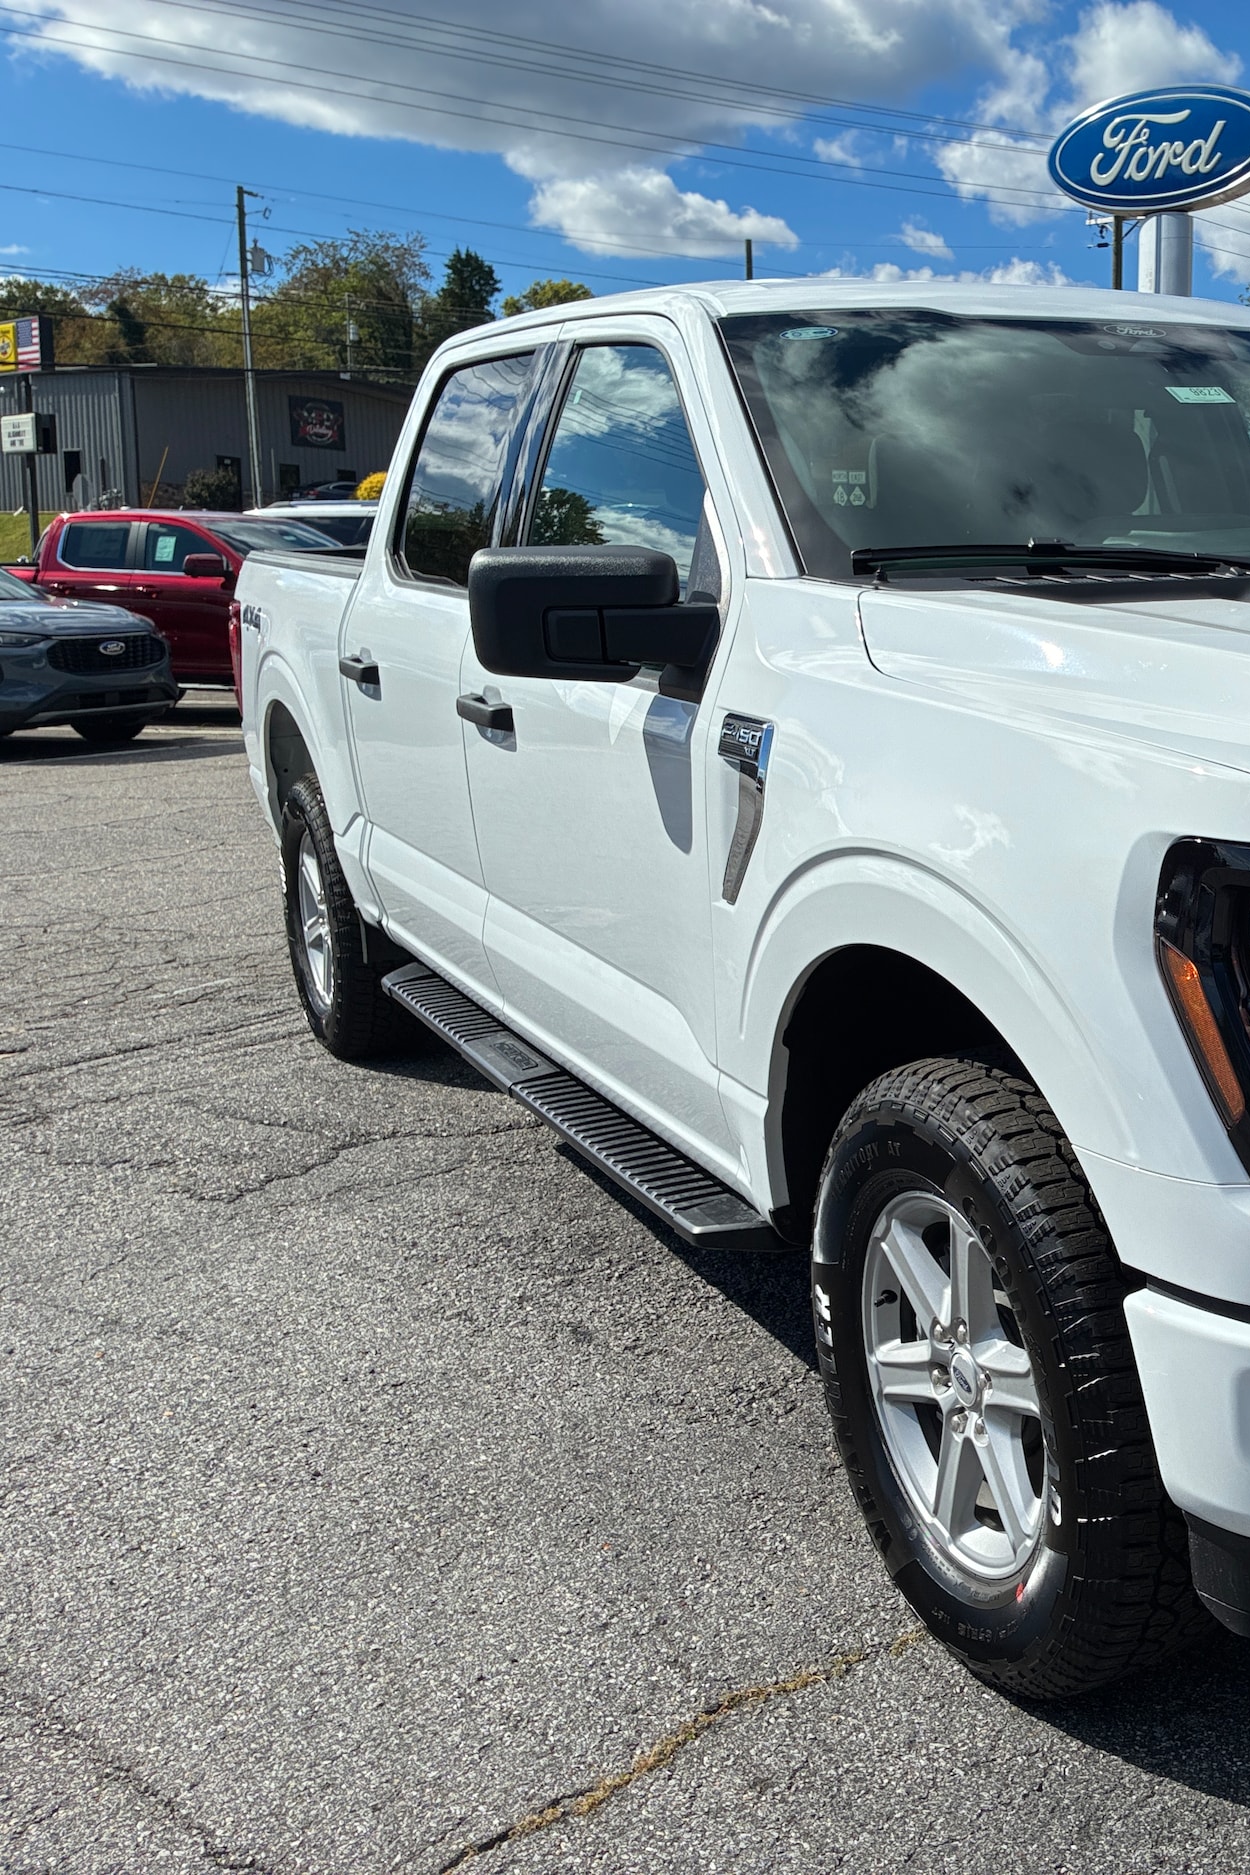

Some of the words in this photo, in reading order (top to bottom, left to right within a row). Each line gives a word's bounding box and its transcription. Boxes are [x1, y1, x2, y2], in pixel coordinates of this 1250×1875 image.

[1090, 109, 1227, 187] Ford
[1116, 326, 1157, 336] Ford
[954, 1369, 970, 1391] Ford
[812, 1284, 893, 1560] WRANGLER
